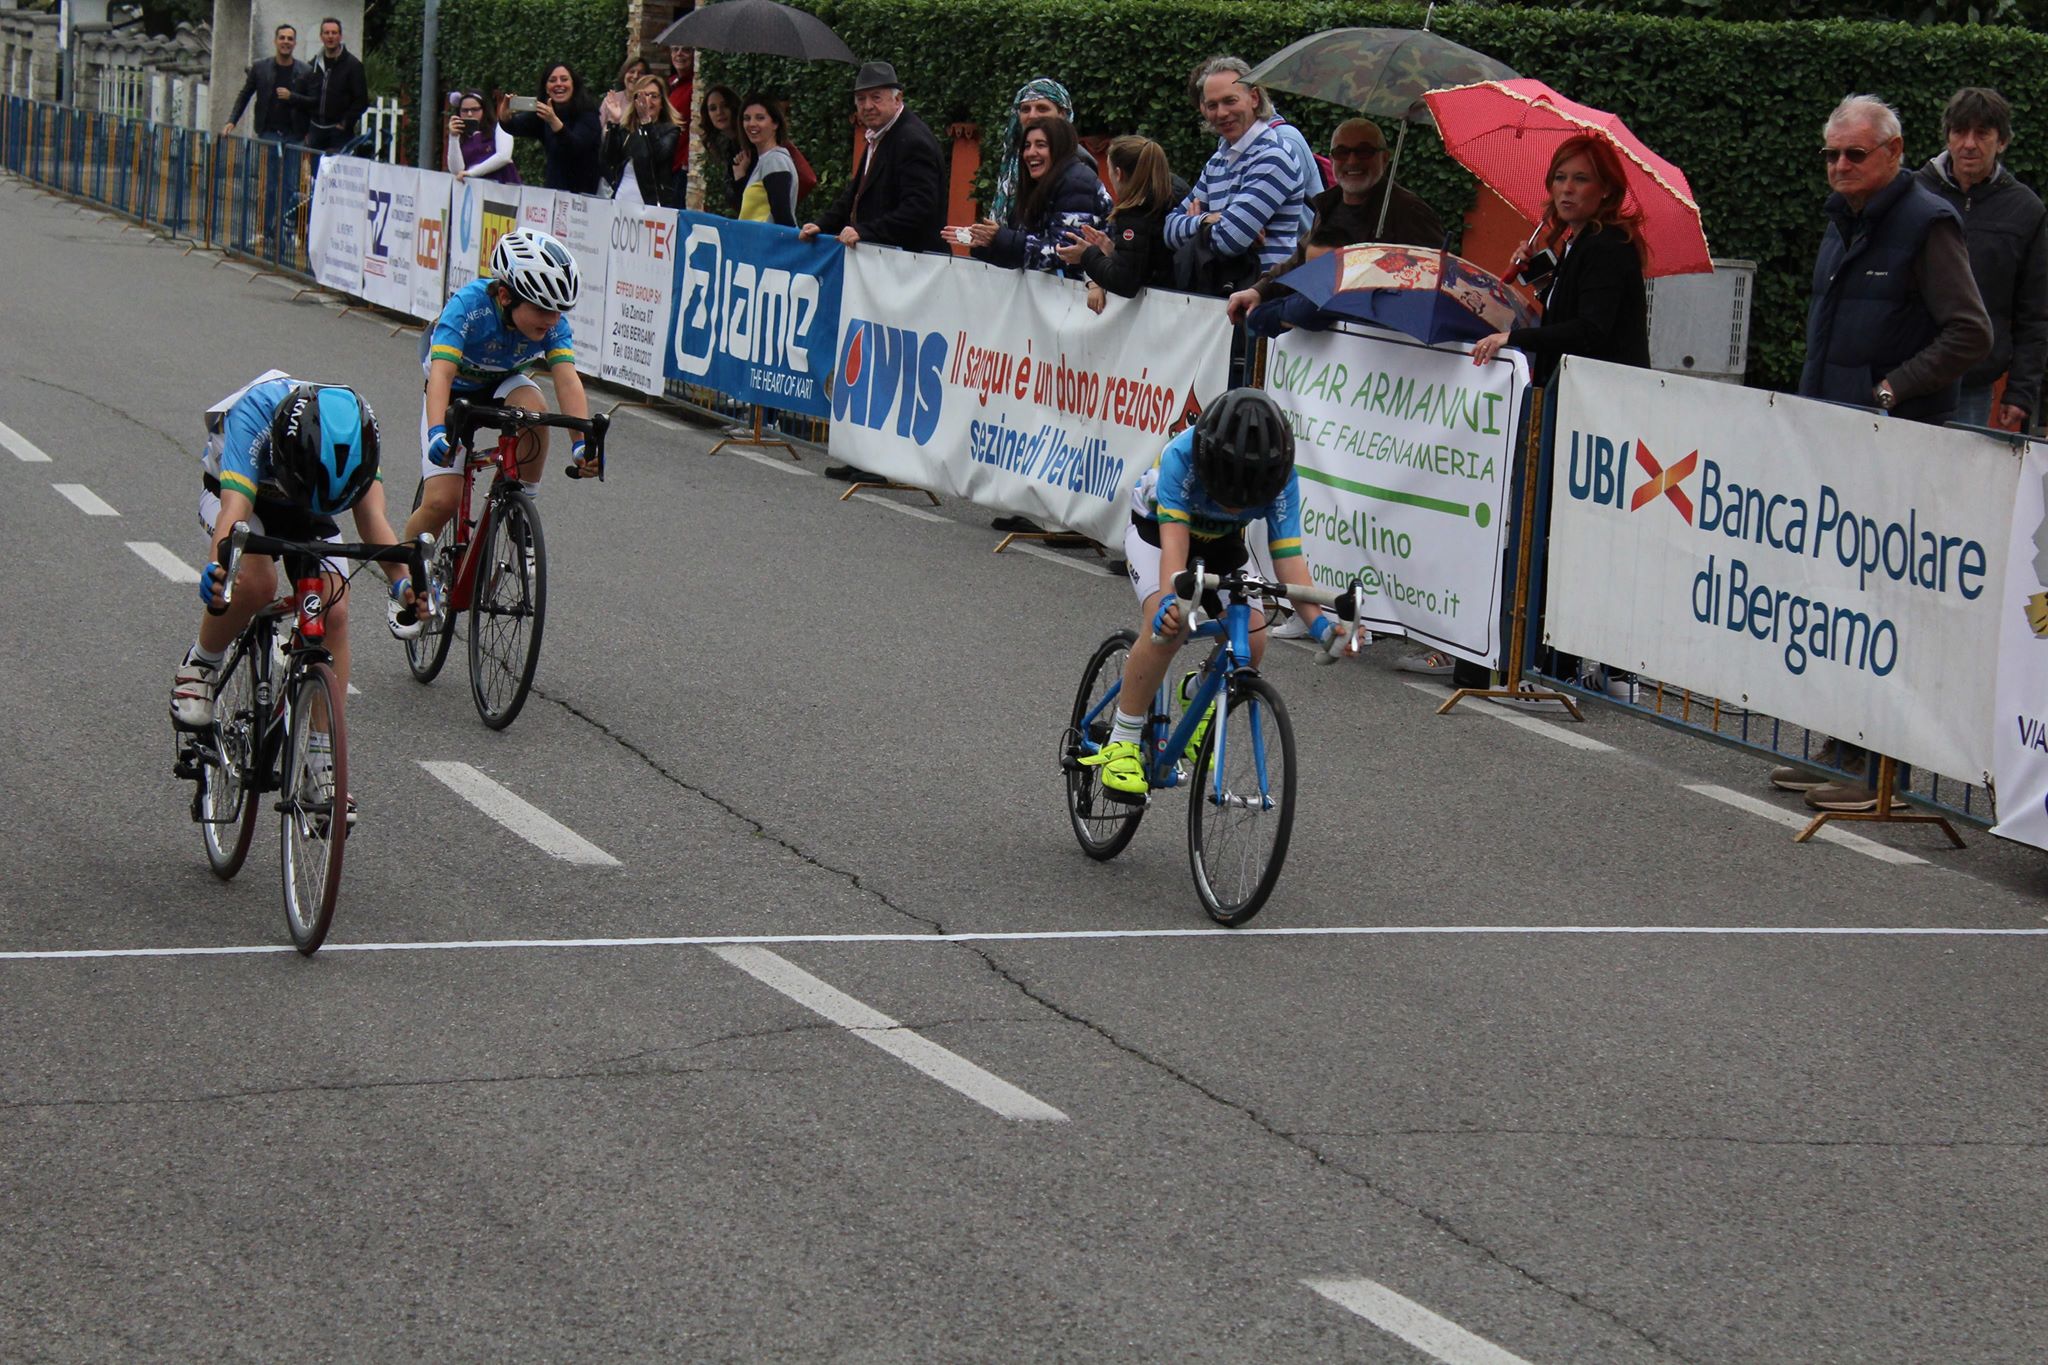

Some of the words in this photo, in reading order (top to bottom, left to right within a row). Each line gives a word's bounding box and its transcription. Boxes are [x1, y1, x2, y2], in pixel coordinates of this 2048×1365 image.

[750, 368, 761, 389] THE
[763, 370, 784, 394] HEART
[783, 374, 795, 395] OF
[795, 376, 814, 400] KART
[950, 331, 967, 385] Il
[1014, 338, 1032, 400] è
[1034, 361, 1053, 407] un
[1056, 353, 1099, 419] dono
[1272, 350, 1349, 405] OMAR
[1351, 372, 1503, 436] ARMANNI
[1316, 420, 1336, 447] E
[1333, 425, 1494, 483] FALEGNAMERIA
[1568, 430, 1629, 509] UBI
[1699, 459, 1808, 554] Banca
[1813, 484, 1987, 600] Popolare
[1692, 555, 1720, 626] di
[1726, 559, 1898, 676] Bergamo
